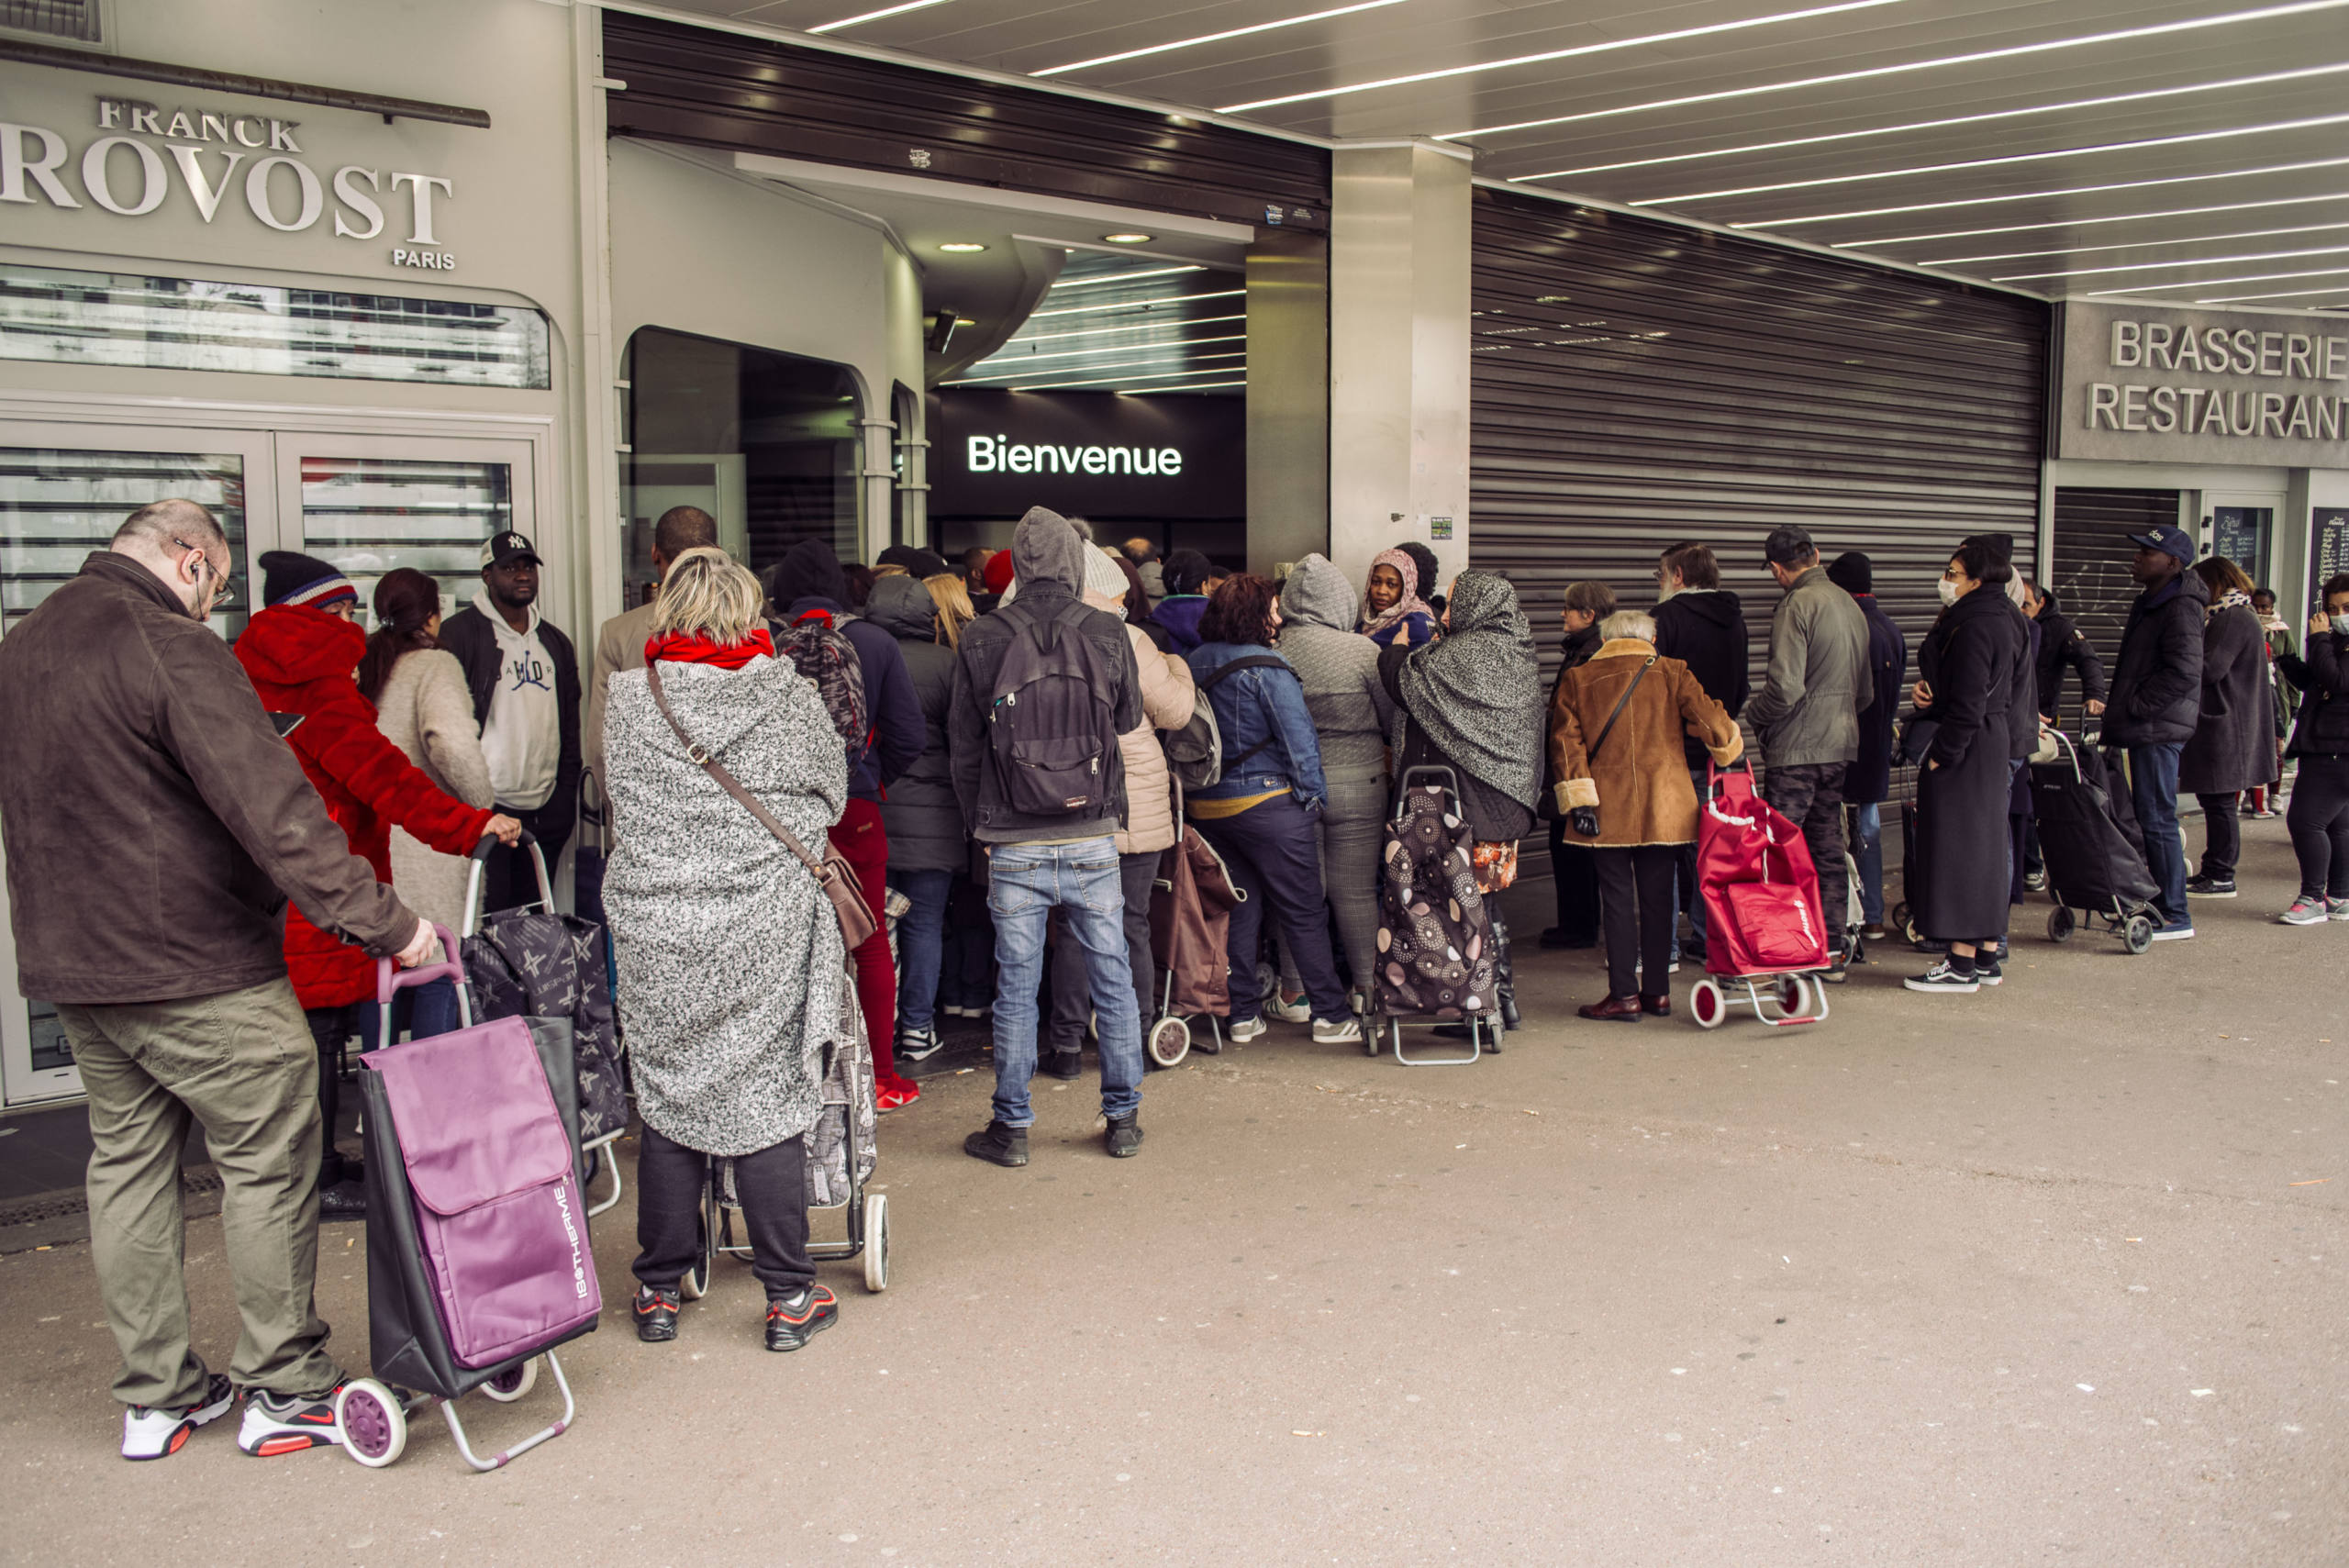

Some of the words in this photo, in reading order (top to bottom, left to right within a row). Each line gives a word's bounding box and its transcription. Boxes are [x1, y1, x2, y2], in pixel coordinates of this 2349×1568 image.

[95, 95, 304, 153] FRANCK
[392, 249, 456, 271] PARIS
[2111, 320, 2349, 381] BRASSERIE
[968, 434, 1182, 475] Bienvenue
[507, 535, 527, 550] NY
[553, 1185, 588, 1299] ISOTHERME
